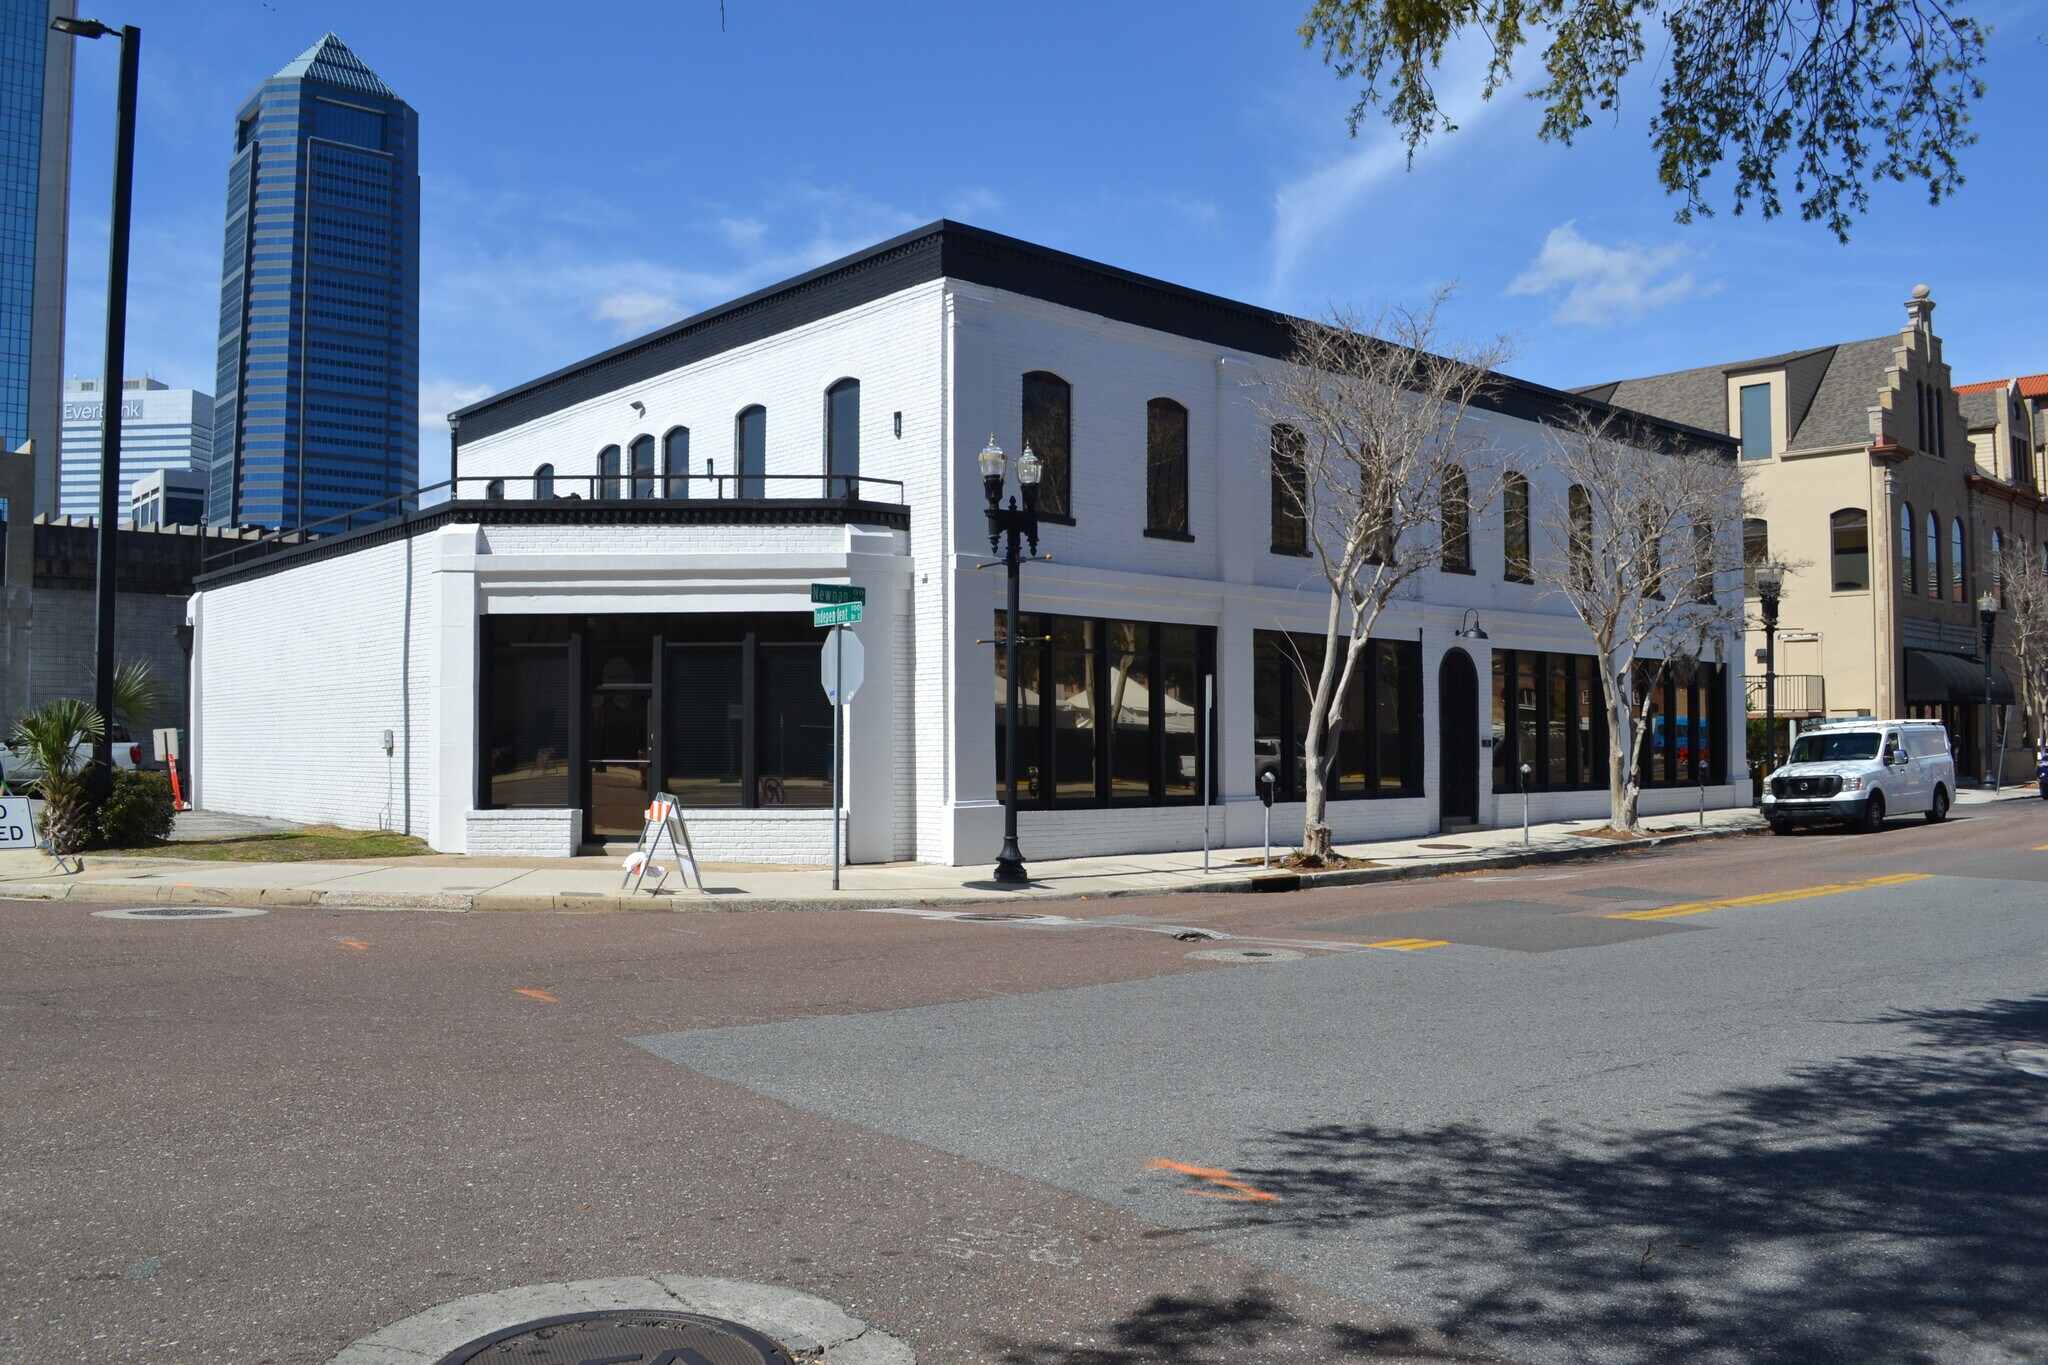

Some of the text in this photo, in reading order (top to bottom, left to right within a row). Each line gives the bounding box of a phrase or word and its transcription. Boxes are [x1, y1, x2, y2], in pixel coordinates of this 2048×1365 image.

[64, 402, 140, 419] Evernk
[813, 586, 849, 602] Newnan
[815, 606, 848, 624] Independent
